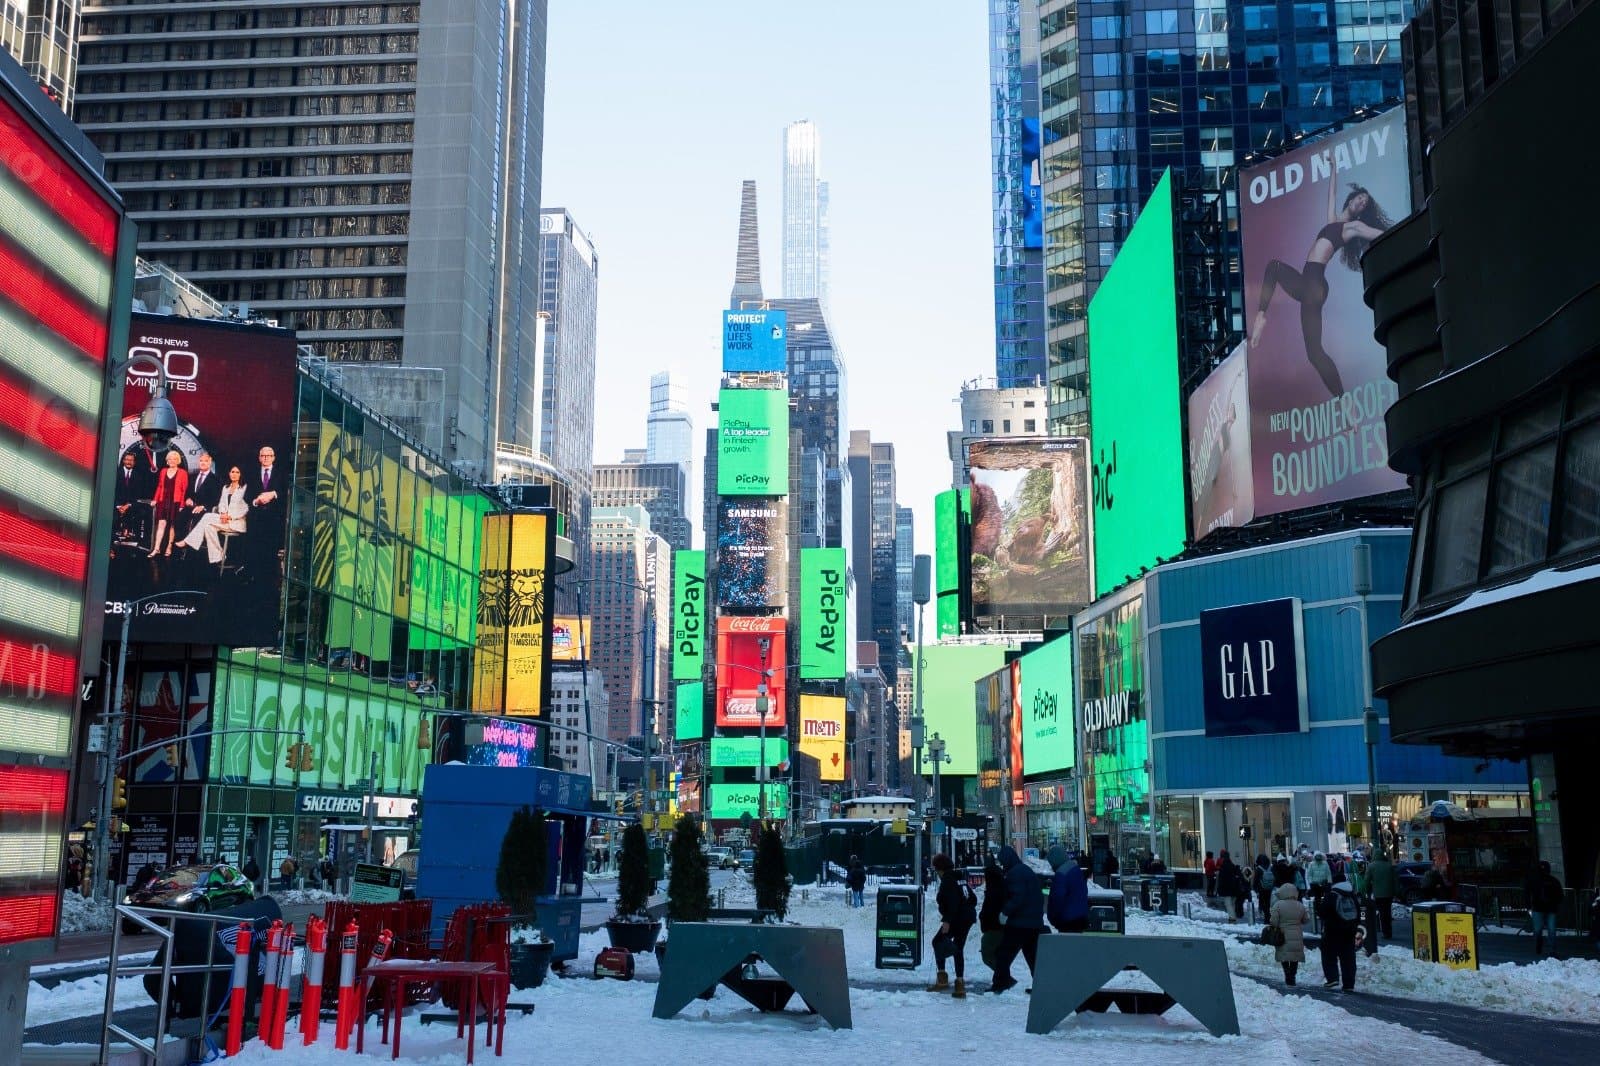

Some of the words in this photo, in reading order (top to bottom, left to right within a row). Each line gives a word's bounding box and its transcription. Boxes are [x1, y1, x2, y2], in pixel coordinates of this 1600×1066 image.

[1250, 162, 1304, 204] OLD
[1311, 125, 1391, 183] NAVY
[727, 314, 767, 323] PROTECT
[727, 324, 752, 332] YOUR
[146, 337, 162, 345] CBS
[164, 339, 189, 347] NEWS
[728, 333, 752, 341] LIFE'S
[728, 342, 753, 350] WORK
[126, 376, 197, 392] MINTES
[1270, 411, 1289, 433] NEW
[723, 428, 730, 436] A
[731, 428, 744, 437] top
[745, 428, 770, 436] leader
[735, 474, 770, 485] PicPay
[728, 509, 777, 518] SAMSUNG
[676, 573, 705, 657] PicPay
[815, 569, 843, 654] PicPay
[729, 617, 770, 631] Coca-Cola
[1220, 639, 1275, 700] GAP
[1033, 688, 1058, 722] PicPay
[1084, 699, 1102, 733] OLD
[1103, 690, 1130, 729] NAVY
[286, 703, 346, 776] CBS
[301, 795, 362, 813] SKECHERS
[1149, 891, 1162, 907] 15
